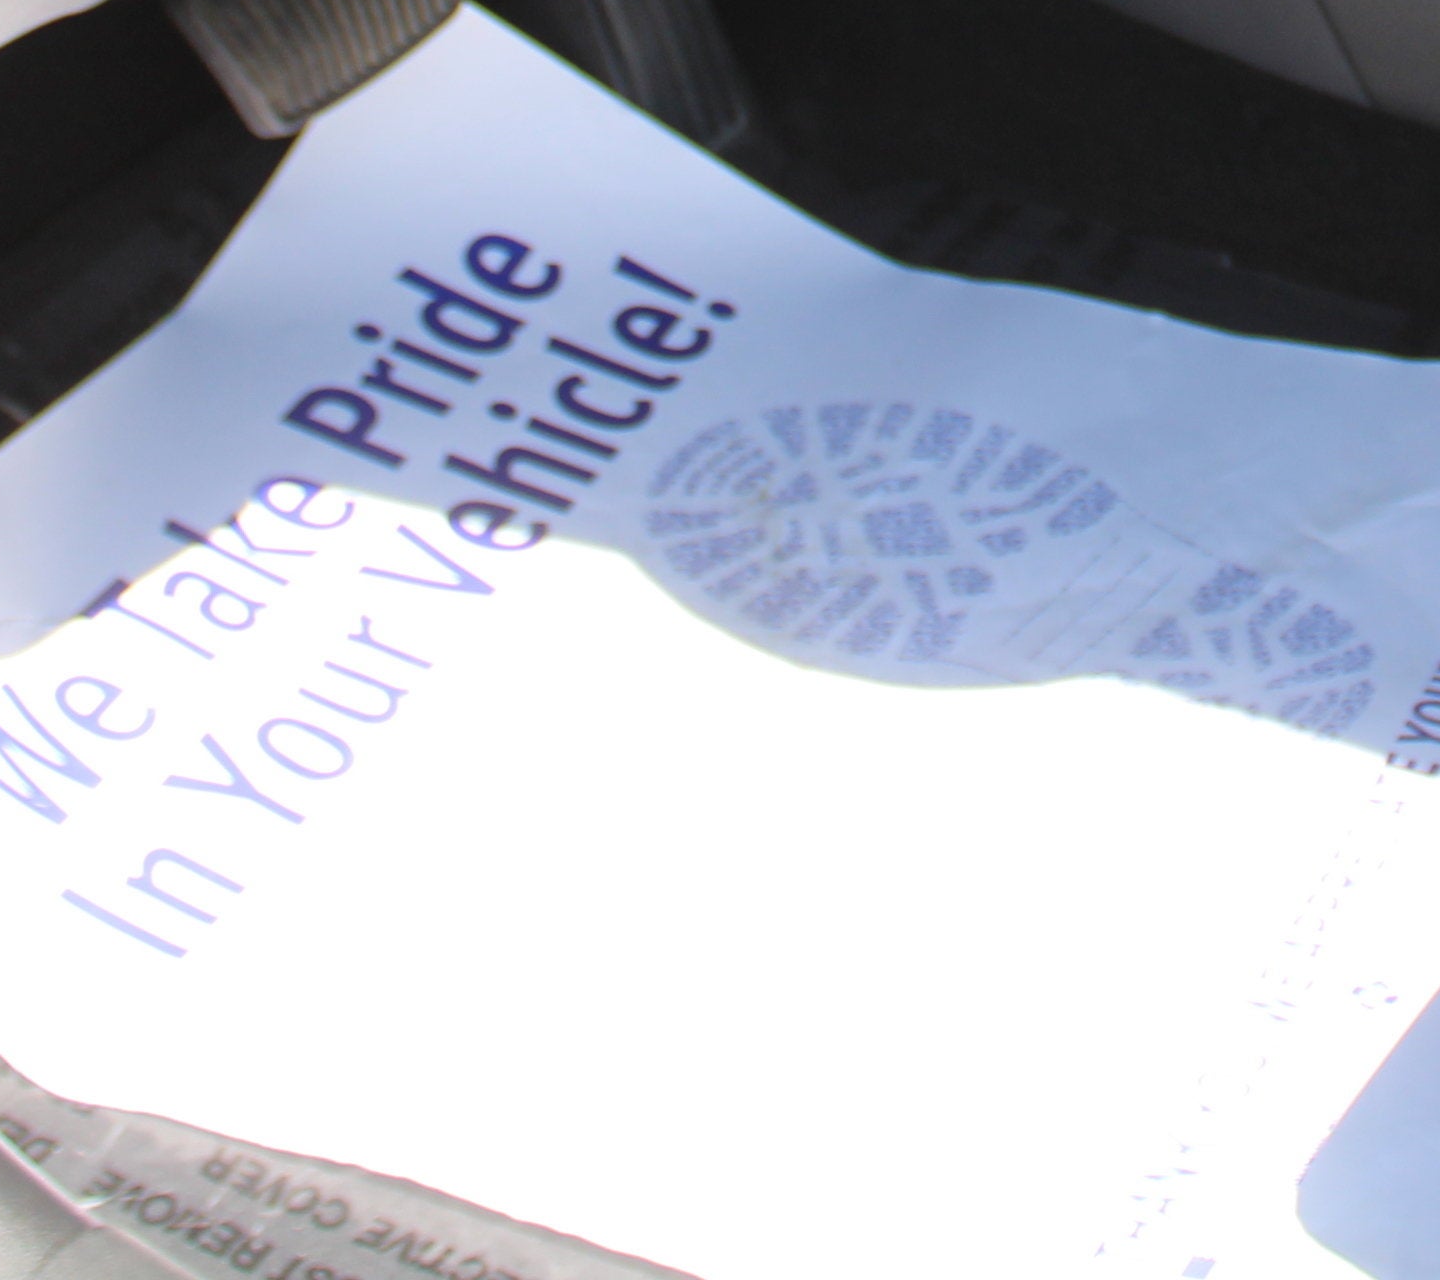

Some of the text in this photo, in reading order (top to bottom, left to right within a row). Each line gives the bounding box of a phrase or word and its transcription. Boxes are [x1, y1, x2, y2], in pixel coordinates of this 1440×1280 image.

[61, 255, 738, 959] In Your Vehicle!
[80, 474, 358, 662] Take
[277, 230, 564, 471] Pride
[199, 1147, 351, 1231] COVER
